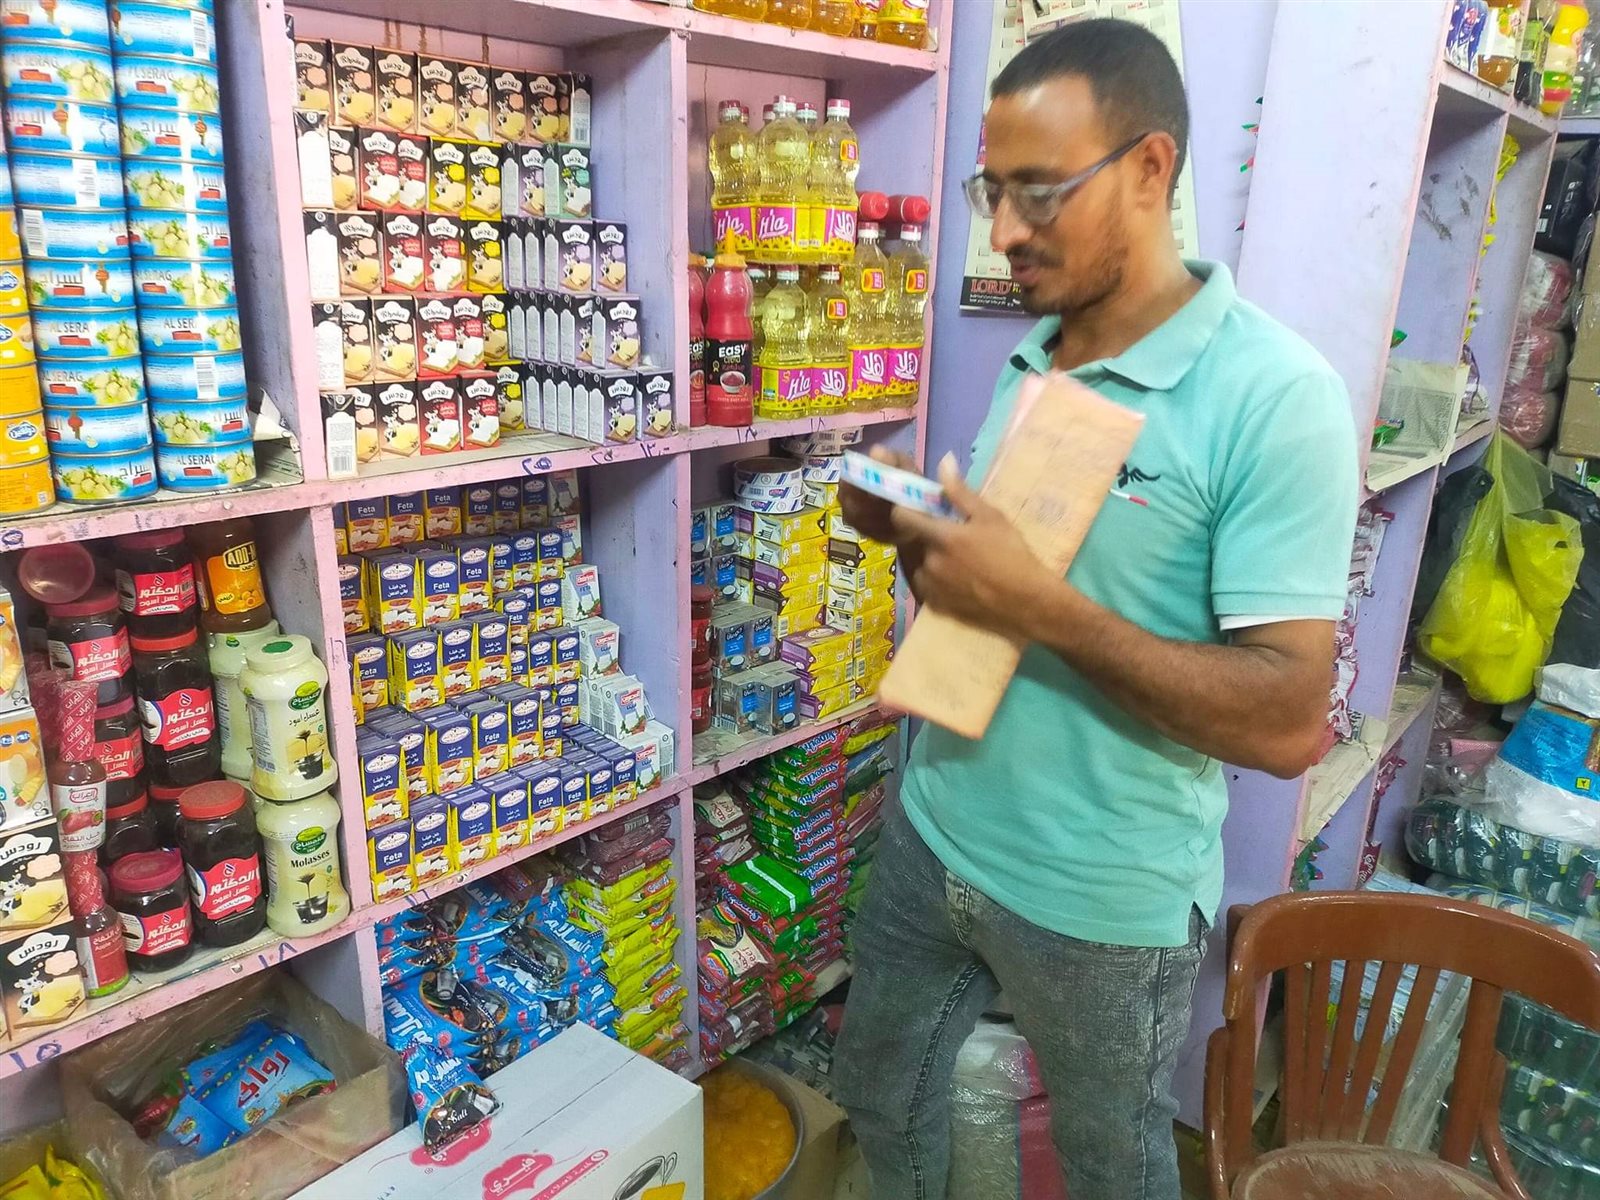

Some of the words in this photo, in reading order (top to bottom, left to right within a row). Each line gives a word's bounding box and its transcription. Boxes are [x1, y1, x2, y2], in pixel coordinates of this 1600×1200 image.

[970, 278, 1012, 295] LORD
[719, 344, 747, 358] Easy
[434, 494, 451, 502] Feta
[357, 506, 376, 514] Feta
[397, 502, 414, 511] Feta
[466, 567, 483, 576] Feta
[433, 582, 450, 590] Feta
[543, 595, 556, 604] Feta
[509, 612, 524, 621] Feta
[562, 649, 575, 658] Feta
[360, 667, 377, 676] Feta
[559, 695, 573, 704] Feta
[166, 703, 210, 726] الدكتور
[484, 732, 500, 742] Feta
[544, 728, 558, 737] Feta
[618, 772, 632, 781] Feta
[568, 791, 582, 800] Feta
[538, 797, 554, 806] Feta
[290, 849, 331, 869] Molasses
[383, 852, 403, 862] Feta
[209, 871, 255, 896] الدكتور
[543, 919, 595, 954] السلام
